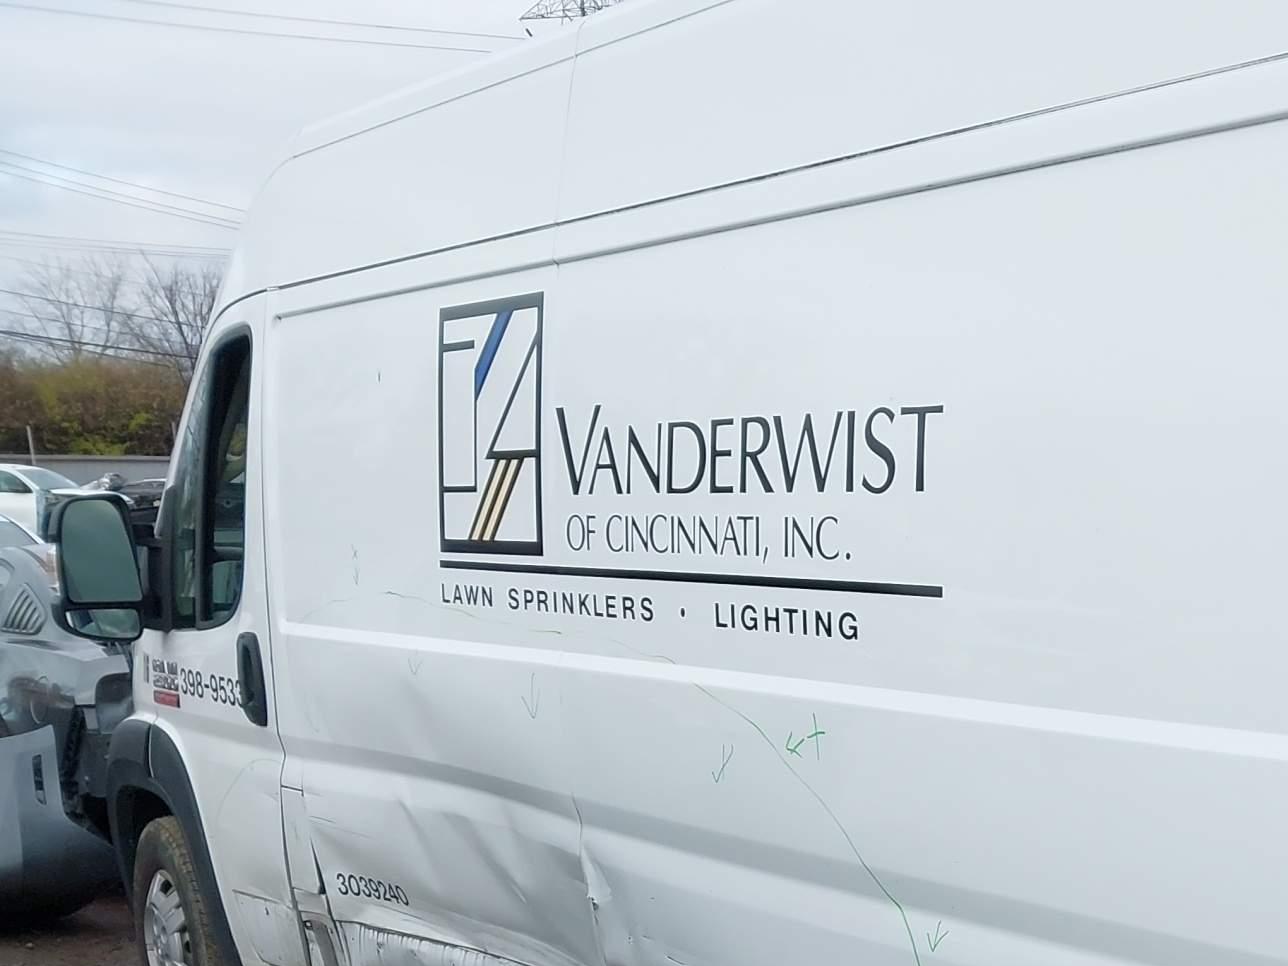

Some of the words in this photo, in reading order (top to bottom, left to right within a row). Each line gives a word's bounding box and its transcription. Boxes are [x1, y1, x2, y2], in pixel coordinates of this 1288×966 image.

[556, 405, 943, 495] VANDERWIST
[567, 515, 595, 550] OF
[607, 515, 767, 561] CINCINNATI,
[785, 517, 850, 559] INC.
[442, 584, 492, 606] LAWN
[509, 589, 653, 621] SPRINKLERS
[716, 603, 857, 640] LIGHTING
[336, 873, 409, 906] 3039240
